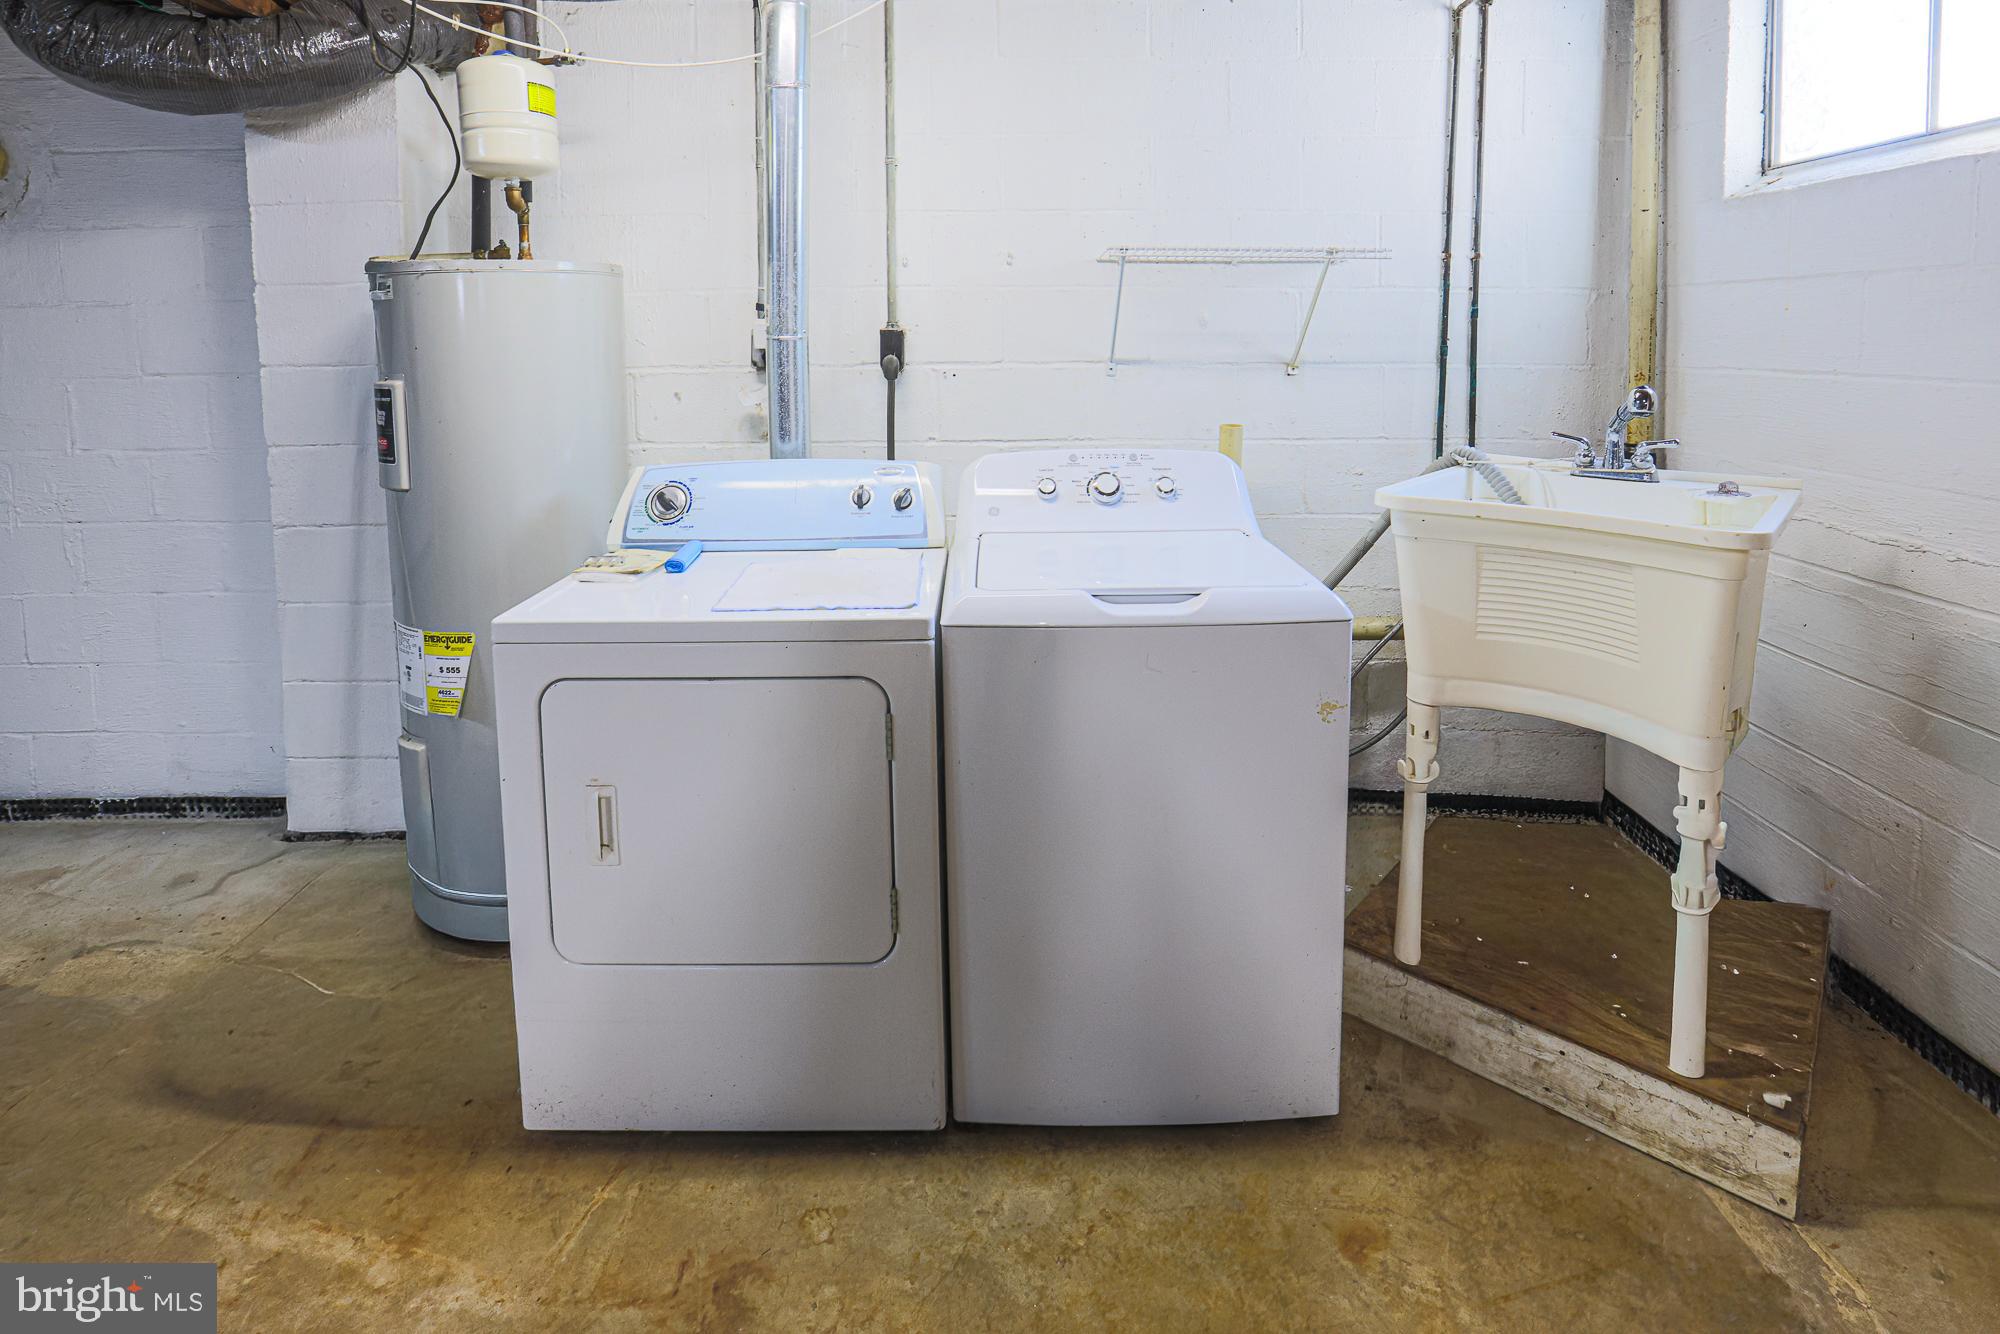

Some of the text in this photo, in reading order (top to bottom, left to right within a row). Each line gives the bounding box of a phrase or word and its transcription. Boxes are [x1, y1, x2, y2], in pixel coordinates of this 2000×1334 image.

[424, 634, 472, 644] ENERGYGUIDE
[439, 666, 461, 674] $ 555
